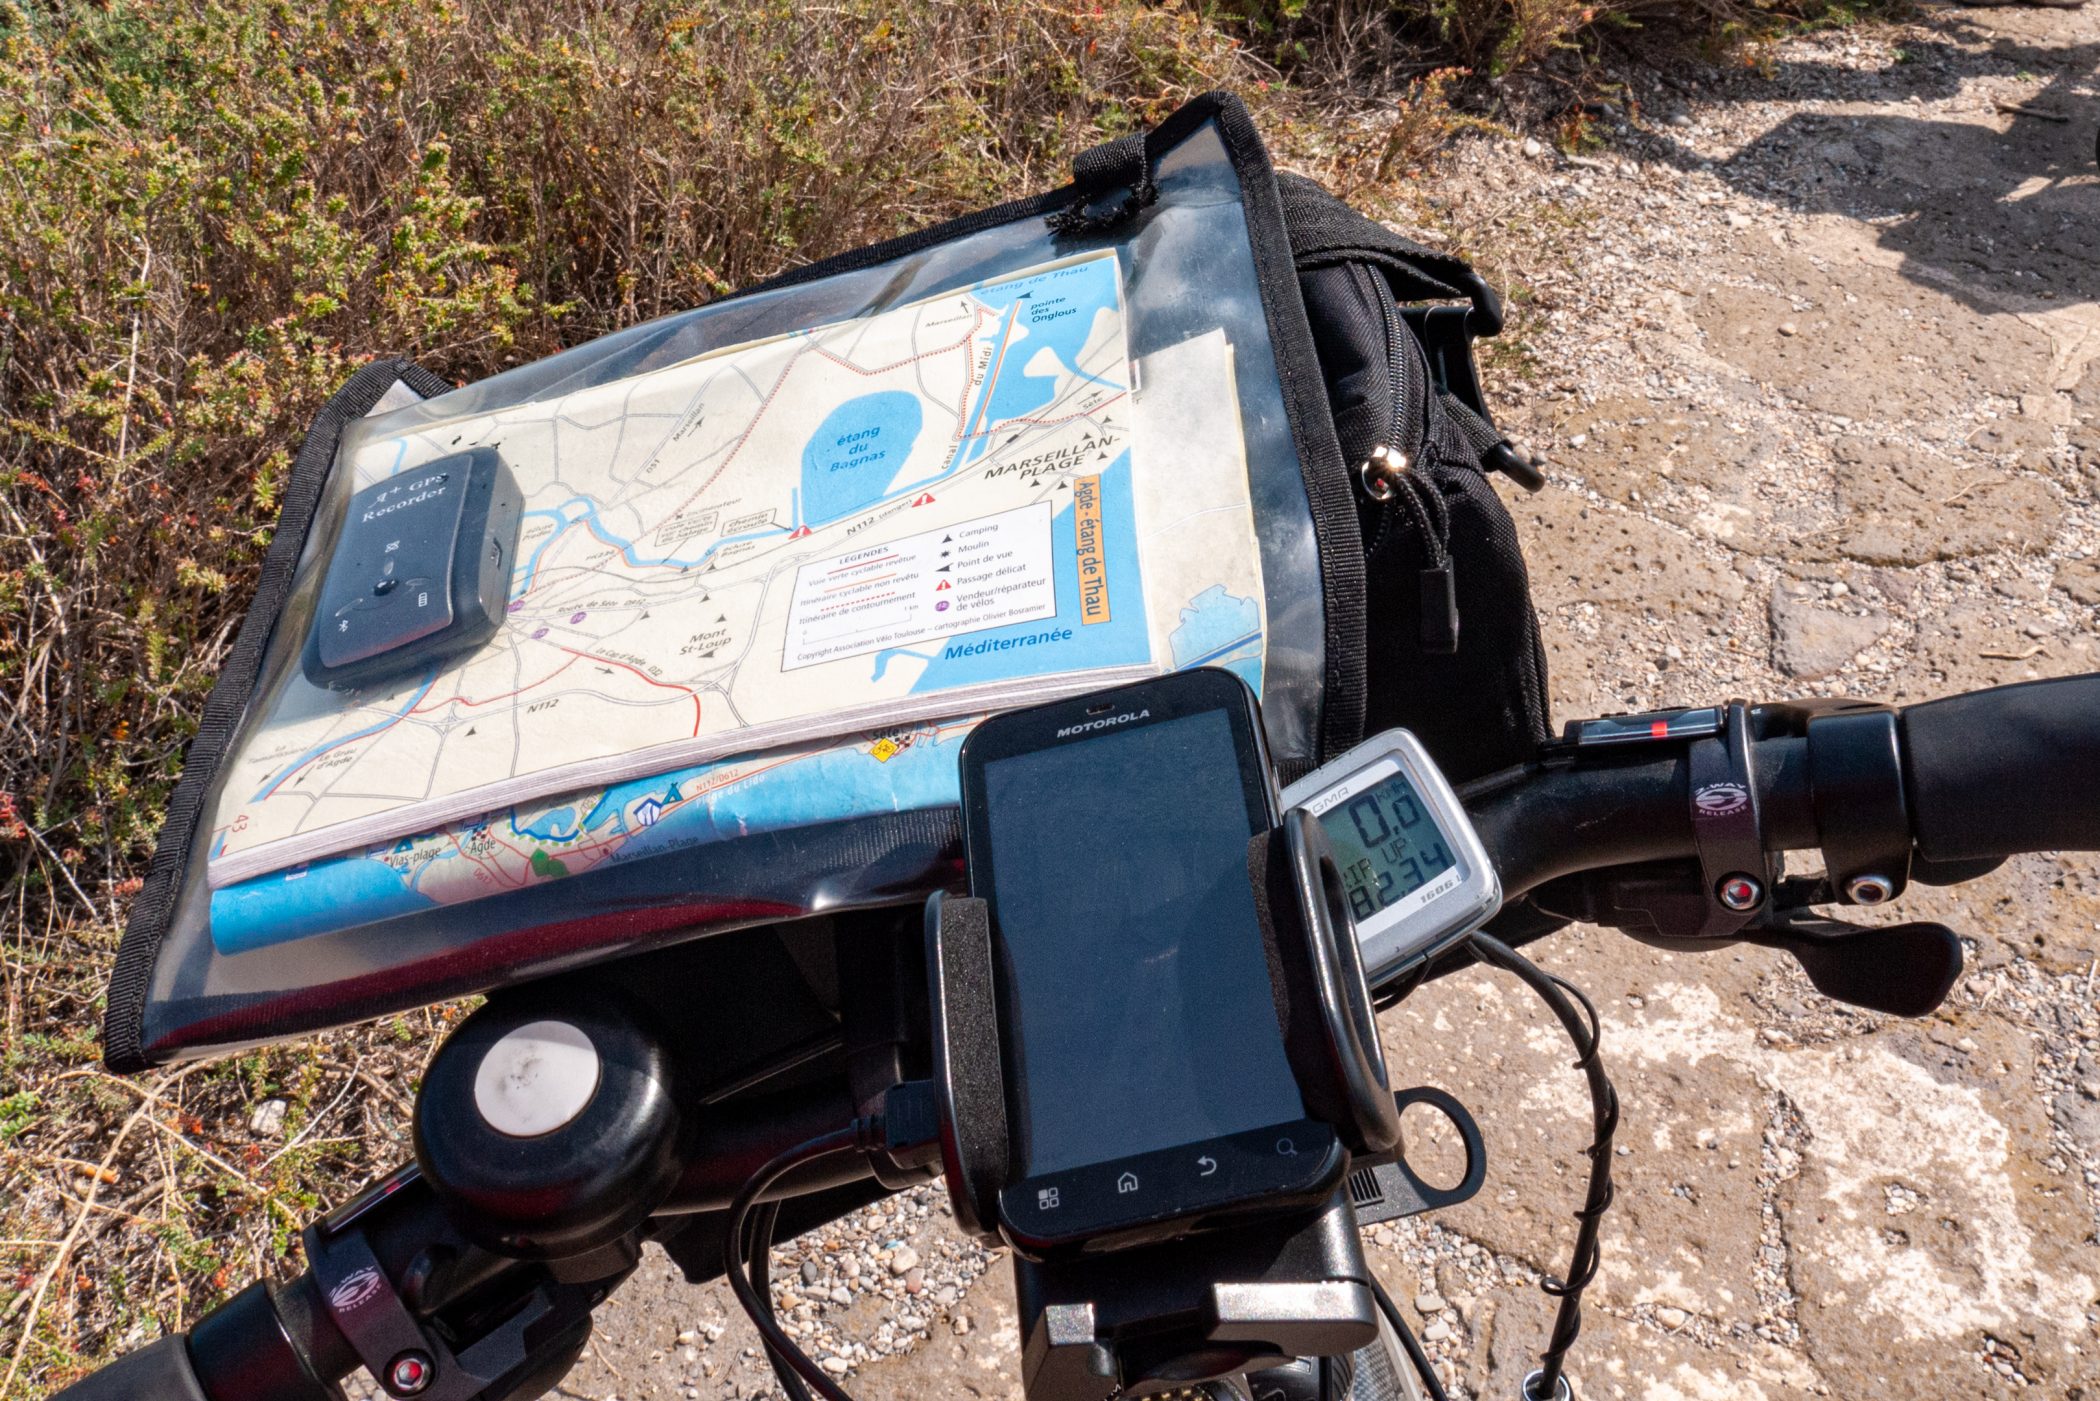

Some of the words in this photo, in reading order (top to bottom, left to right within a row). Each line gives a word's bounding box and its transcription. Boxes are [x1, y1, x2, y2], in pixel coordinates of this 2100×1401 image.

[1053, 265, 1088, 279] Thau
[1030, 297, 1066, 310] pointe
[1031, 307, 1050, 316] des
[1032, 307, 1077, 323] Onglous
[974, 371, 982, 386] du
[979, 346, 993, 370] Midi
[673, 402, 705, 442] Marseillan
[836, 426, 881, 446] étang
[848, 442, 869, 455] du
[984, 435, 1121, 479] MARSEILLAN-
[830, 450, 886, 472] Bagnas
[1020, 454, 1085, 480] PLAGE
[362, 487, 447, 523] Recorder
[1074, 481, 1099, 510] Agde
[846, 516, 875, 535] N112
[959, 523, 999, 538] Camping
[958, 540, 990, 553] Moulin
[1076, 518, 1101, 556] étang
[957, 558, 980, 568] Point
[982, 555, 994, 563] de
[996, 550, 1013, 560] vue
[1082, 557, 1103, 575] de
[828, 571, 849, 582] verte
[850, 562, 884, 578] cyclable
[956, 571, 993, 585] Passage
[995, 563, 1027, 576] délicat
[839, 584, 873, 598] cyclable
[874, 579, 891, 587] non
[892, 571, 920, 584] revêtu
[956, 578, 1046, 602] Vendeur/réparateur
[838, 608, 850, 616] de
[851, 592, 916, 613] contournement
[956, 603, 968, 611] de
[970, 598, 995, 609] vélos
[1083, 576, 1105, 616] Thau
[679, 636, 732, 656] St-Loup
[690, 627, 727, 643] Mont
[797, 647, 832, 661] Copyright
[834, 638, 875, 652] Association
[875, 633, 893, 642] Vélo
[893, 627, 926, 639] Toulouse
[934, 616, 981, 631] cartographie
[982, 611, 1007, 621] Olivier
[945, 627, 1073, 660] Méditerranée
[526, 698, 559, 714] N112
[1056, 709, 1151, 739] MOTOROLA
[743, 775, 766, 789] Lido
[1312, 786, 1350, 814] GMA
[1698, 804, 1748, 817] RELEASE
[232, 814, 249, 833] 43
[1348, 793, 1421, 849] 0.0
[389, 846, 442, 869] Vias-plage
[469, 838, 497, 856] Agde
[1381, 837, 1407, 864] UP
[1420, 879, 1454, 904] 1606
